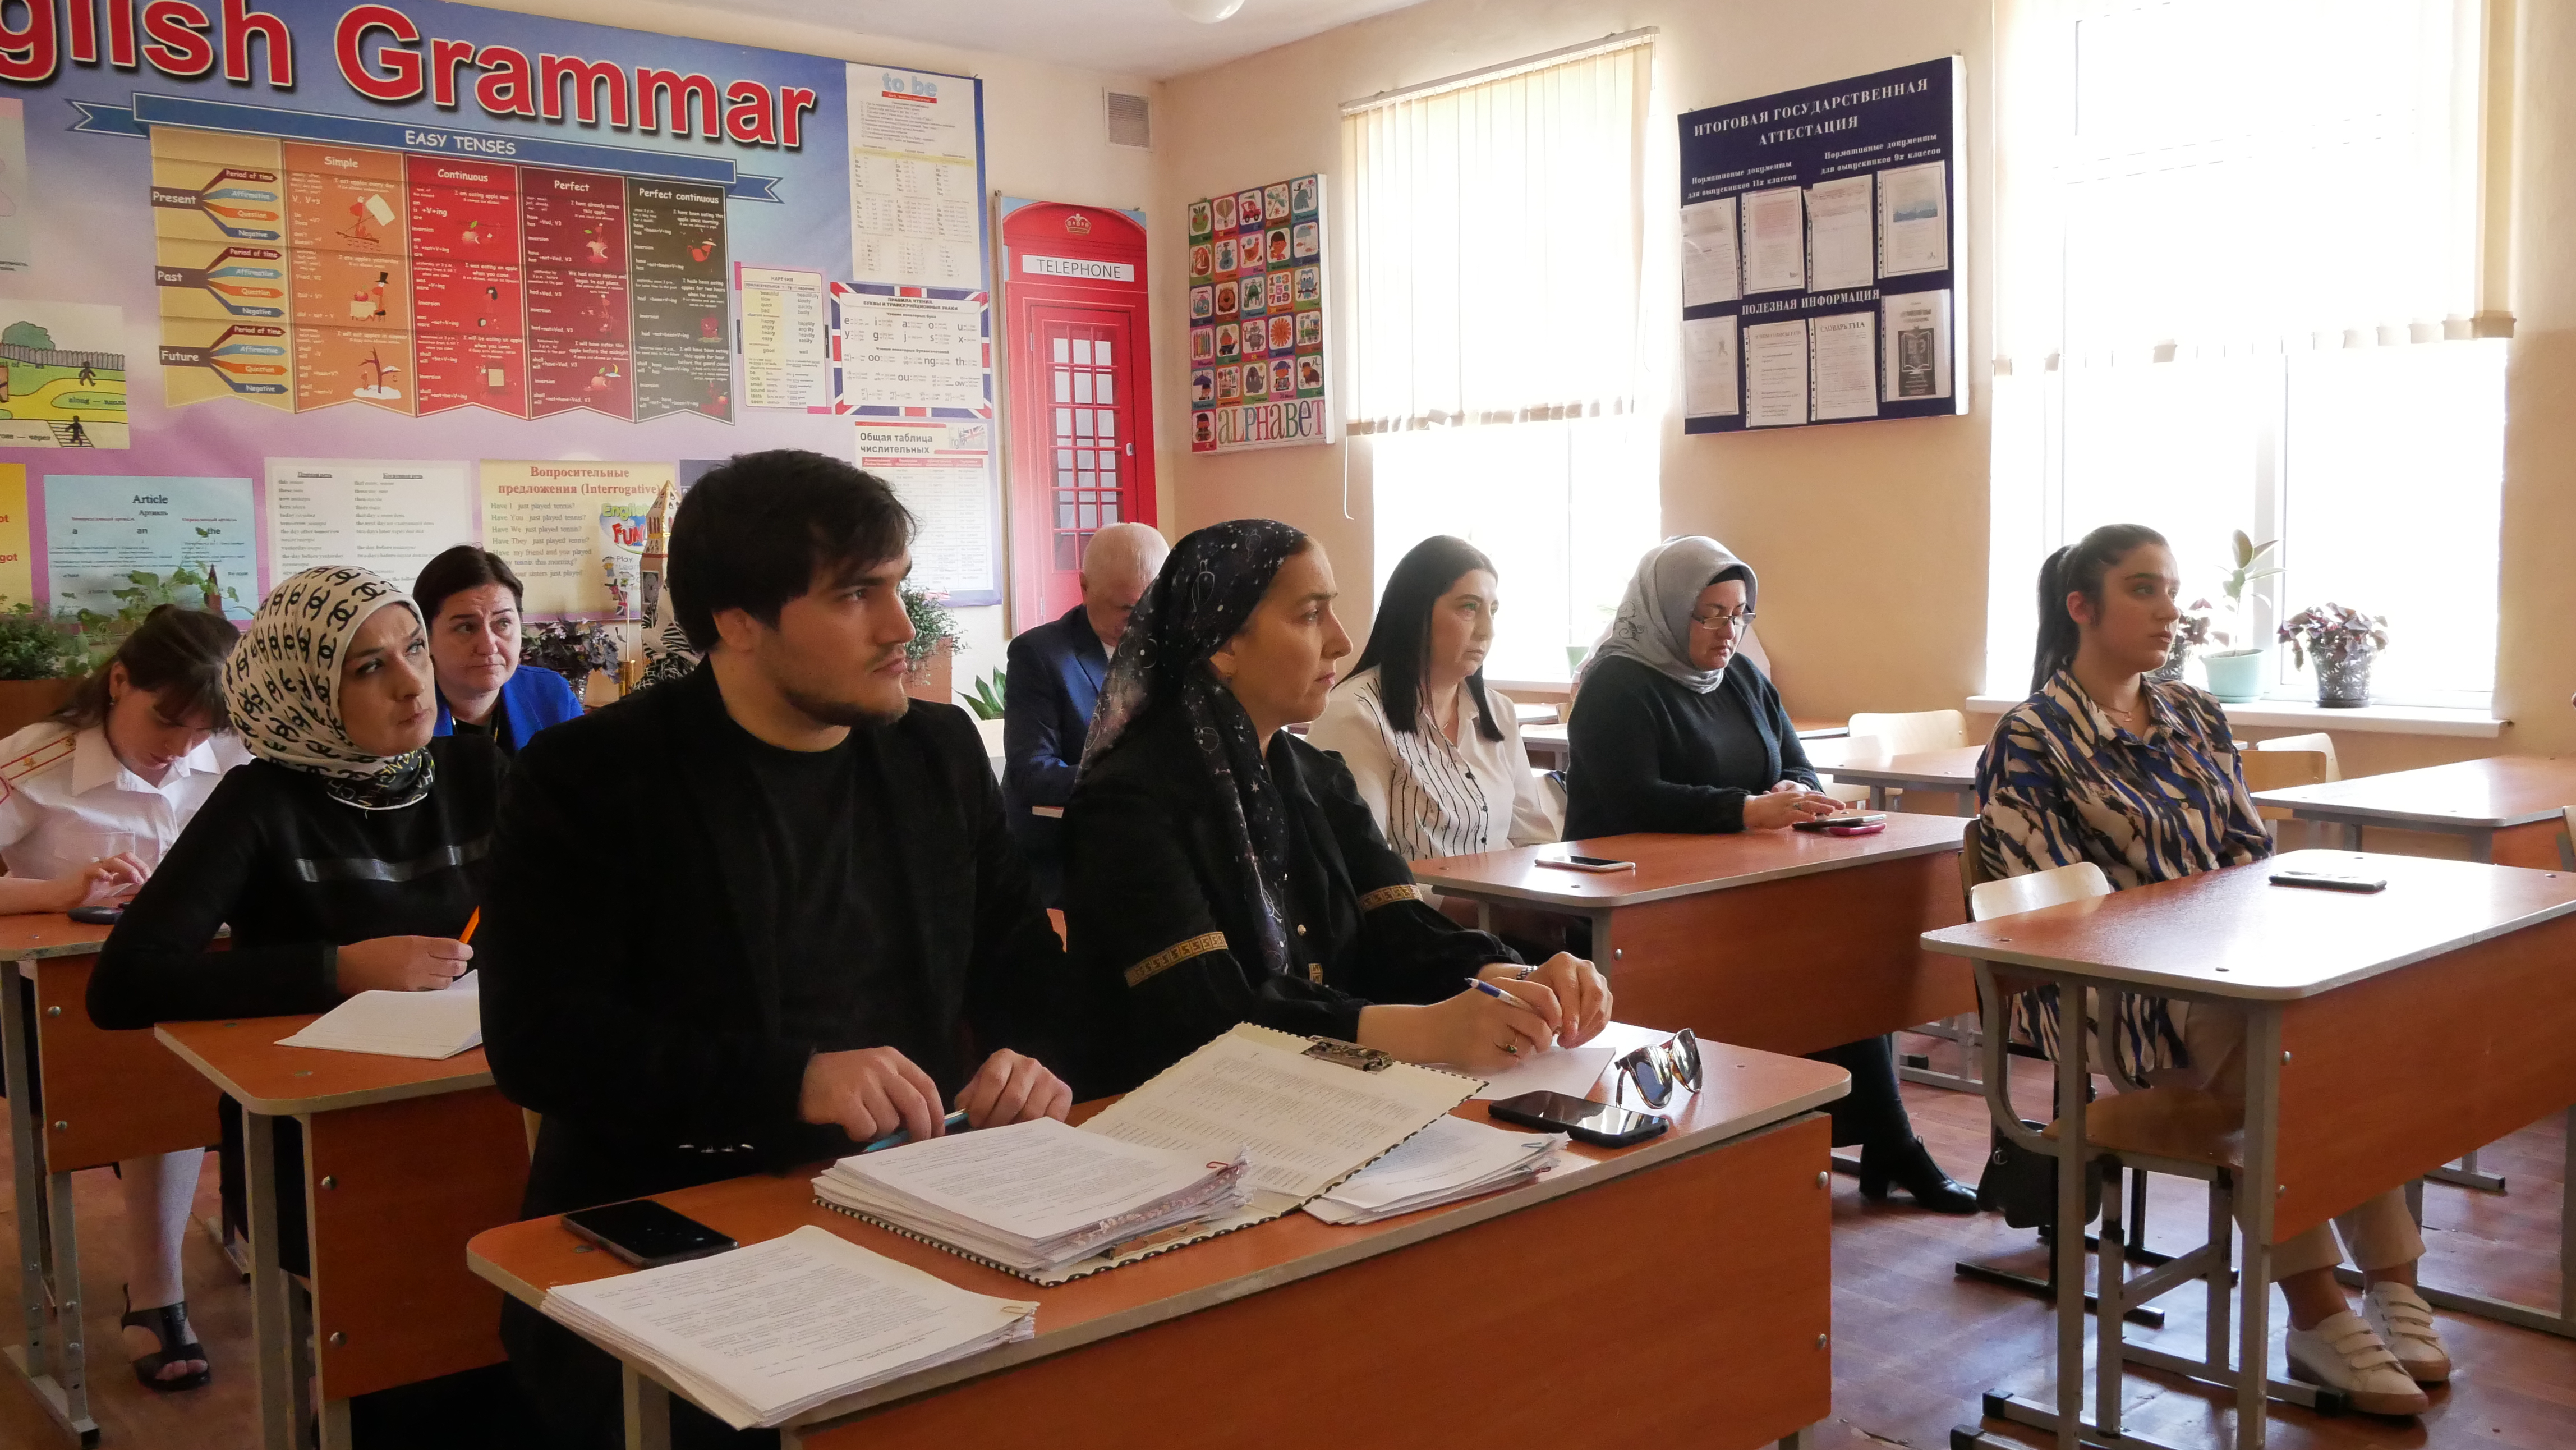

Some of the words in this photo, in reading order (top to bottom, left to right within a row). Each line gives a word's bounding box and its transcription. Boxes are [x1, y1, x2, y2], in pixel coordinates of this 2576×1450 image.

[334, 4, 816, 148] Grammar
[882, 72, 904, 93] to
[912, 76, 937, 97] be
[1694, 111, 1769, 136] ИТОГОВАЯ
[1773, 78, 1928, 121] ГОСУДАРСТВЕННАЯ
[1759, 116, 1859, 146] АТТЕСТАЦИЯ
[405, 130, 447, 147] EASY
[453, 136, 516, 155] TENSES
[1824, 142, 1883, 160] Нормативные
[1887, 133, 1936, 150] документы
[324, 156, 358, 169] Simple
[1820, 166, 1835, 175] для
[1837, 157, 1891, 173] выпускников
[1908, 148, 1941, 159] классов
[226, 170, 247, 178] Period
[438, 169, 488, 182] Continuous
[1691, 169, 1744, 185] Нормативные
[1747, 160, 1792, 176] документы
[554, 180, 590, 192] Perfect
[1687, 190, 1700, 199] для
[1702, 182, 1750, 197] выпускников
[1767, 175, 1797, 185] классов
[153, 191, 196, 204] Present
[231, 190, 270, 199] Affirmative
[639, 188, 673, 199] Perfect
[676, 194, 719, 204] continuous
[1037, 259, 1121, 278] TELEPHONE
[158, 270, 183, 282] Past
[1742, 299, 1797, 316] ПОЛЕЗНАЯ
[1801, 288, 1880, 309] ИНФОРМАЦИЯ
[1849, 321, 1865, 329] ГИА
[844, 330, 850, 339] y
[873, 332, 878, 341] g
[161, 350, 199, 361] Future
[924, 357, 936, 367] ng
[955, 357, 965, 366] th
[246, 384, 275, 393] Negative
[860, 433, 891, 442] Общая
[894, 434, 932, 444] таблица
[530, 466, 629, 480] Вопросительные
[498, 484, 577, 496] предложения
[581, 483, 661, 497] (Interrogative)
[132, 494, 168, 504] Article
[611, 522, 645, 546] FUN
